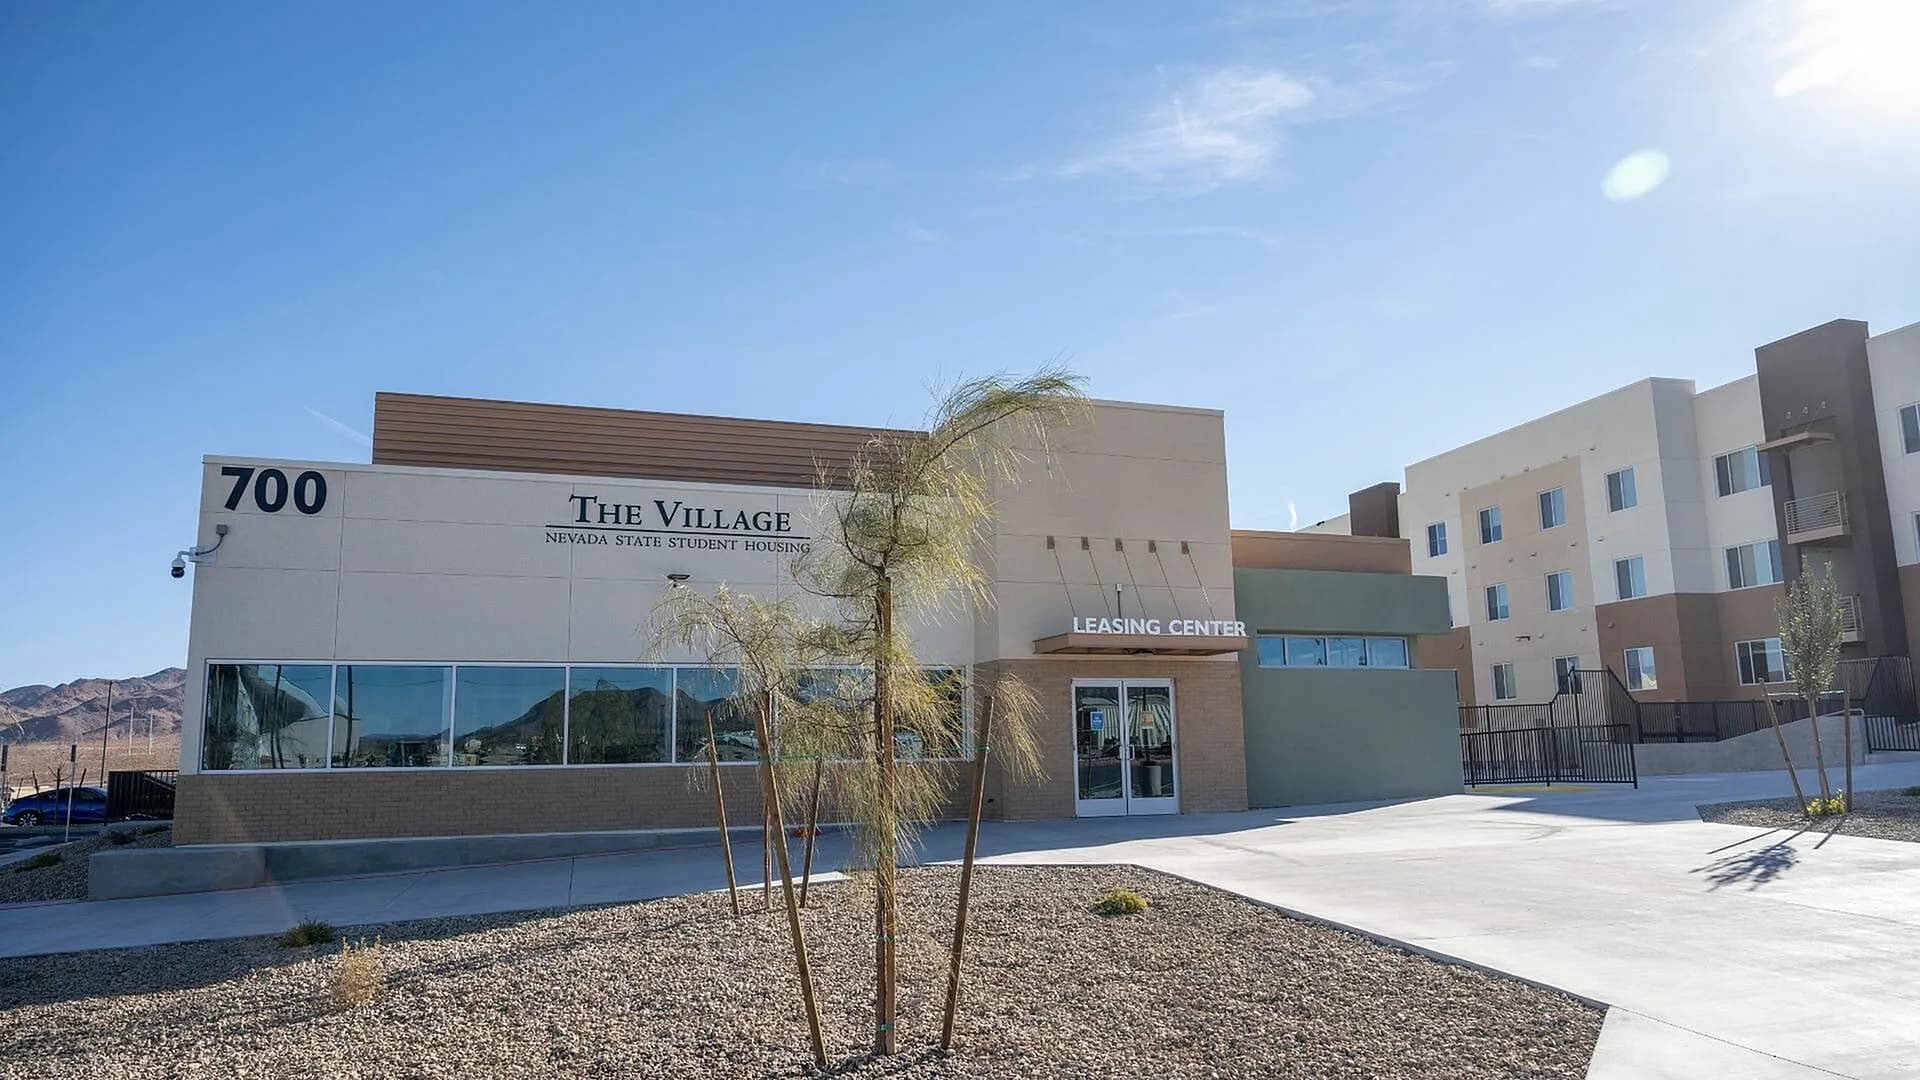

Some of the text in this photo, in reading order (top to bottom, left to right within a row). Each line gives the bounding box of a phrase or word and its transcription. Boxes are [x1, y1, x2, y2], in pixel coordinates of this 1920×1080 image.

[221, 466, 328, 515] 700
[546, 532, 811, 554] NEVADA STATE STUDENT HOUSING
[1073, 617, 1247, 637] LEASING CENTER
